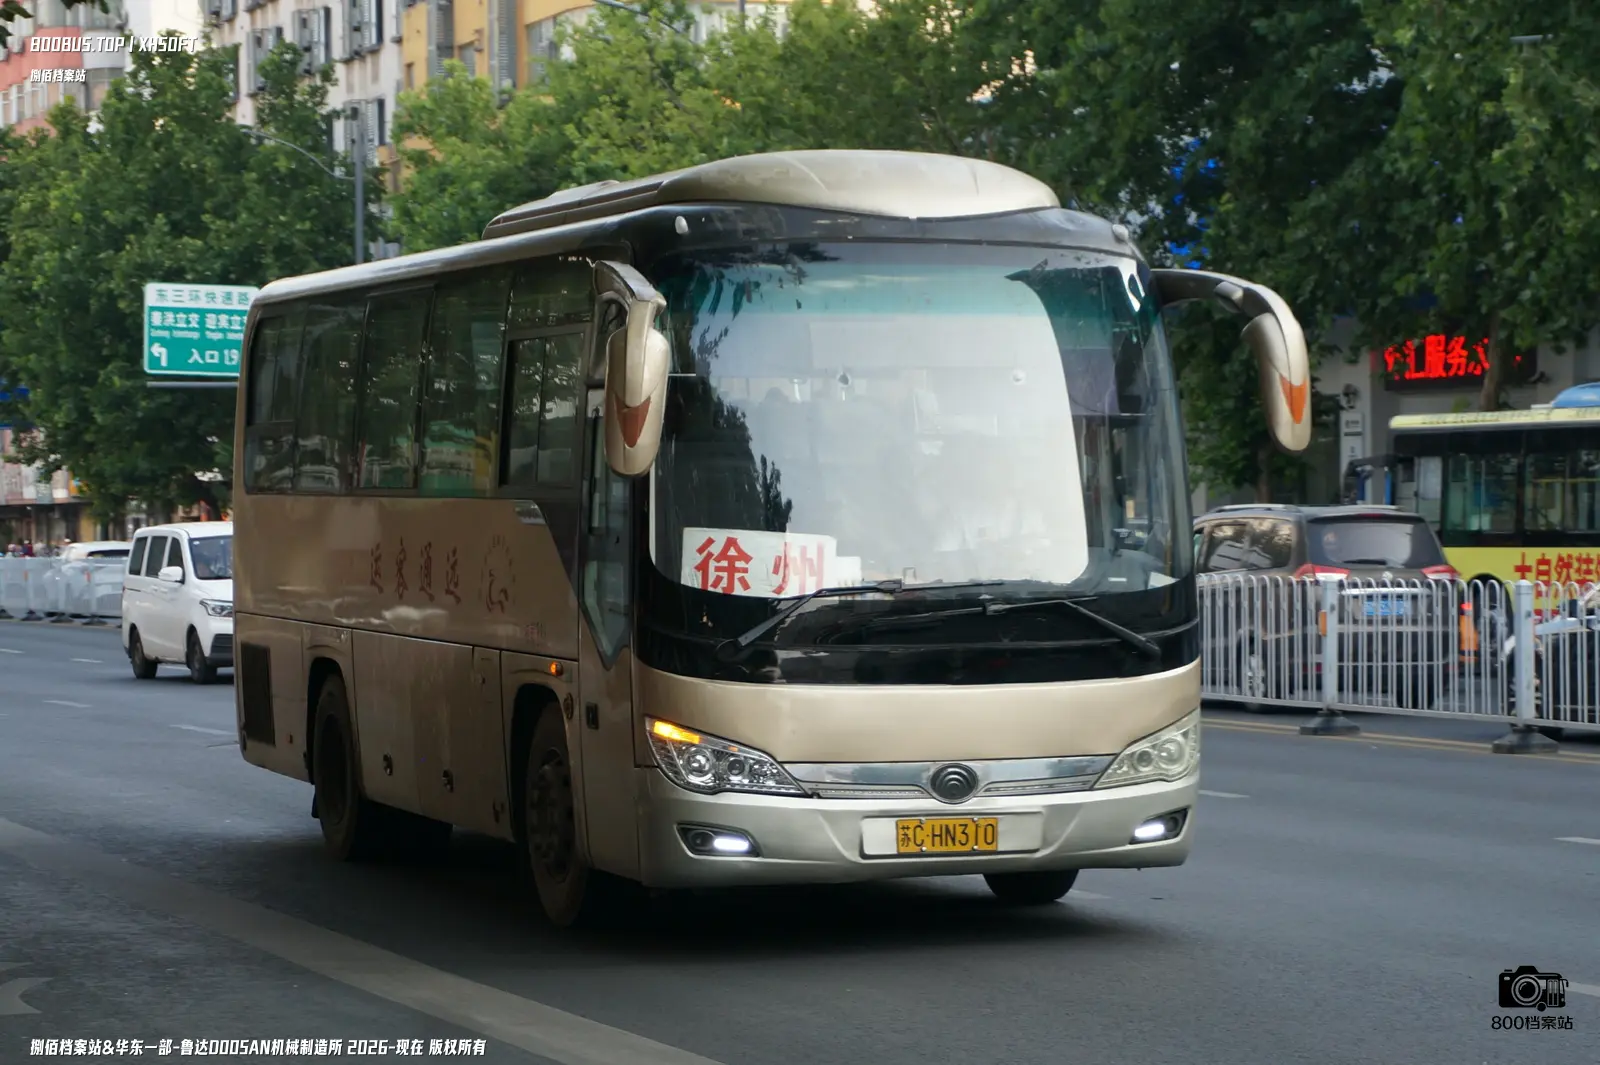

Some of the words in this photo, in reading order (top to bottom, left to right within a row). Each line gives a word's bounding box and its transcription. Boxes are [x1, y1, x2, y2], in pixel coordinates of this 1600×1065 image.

[155, 288, 249, 306] 东三环快速路
[187, 348, 219, 365] 入口
[693, 536, 825, 596] 徐州
